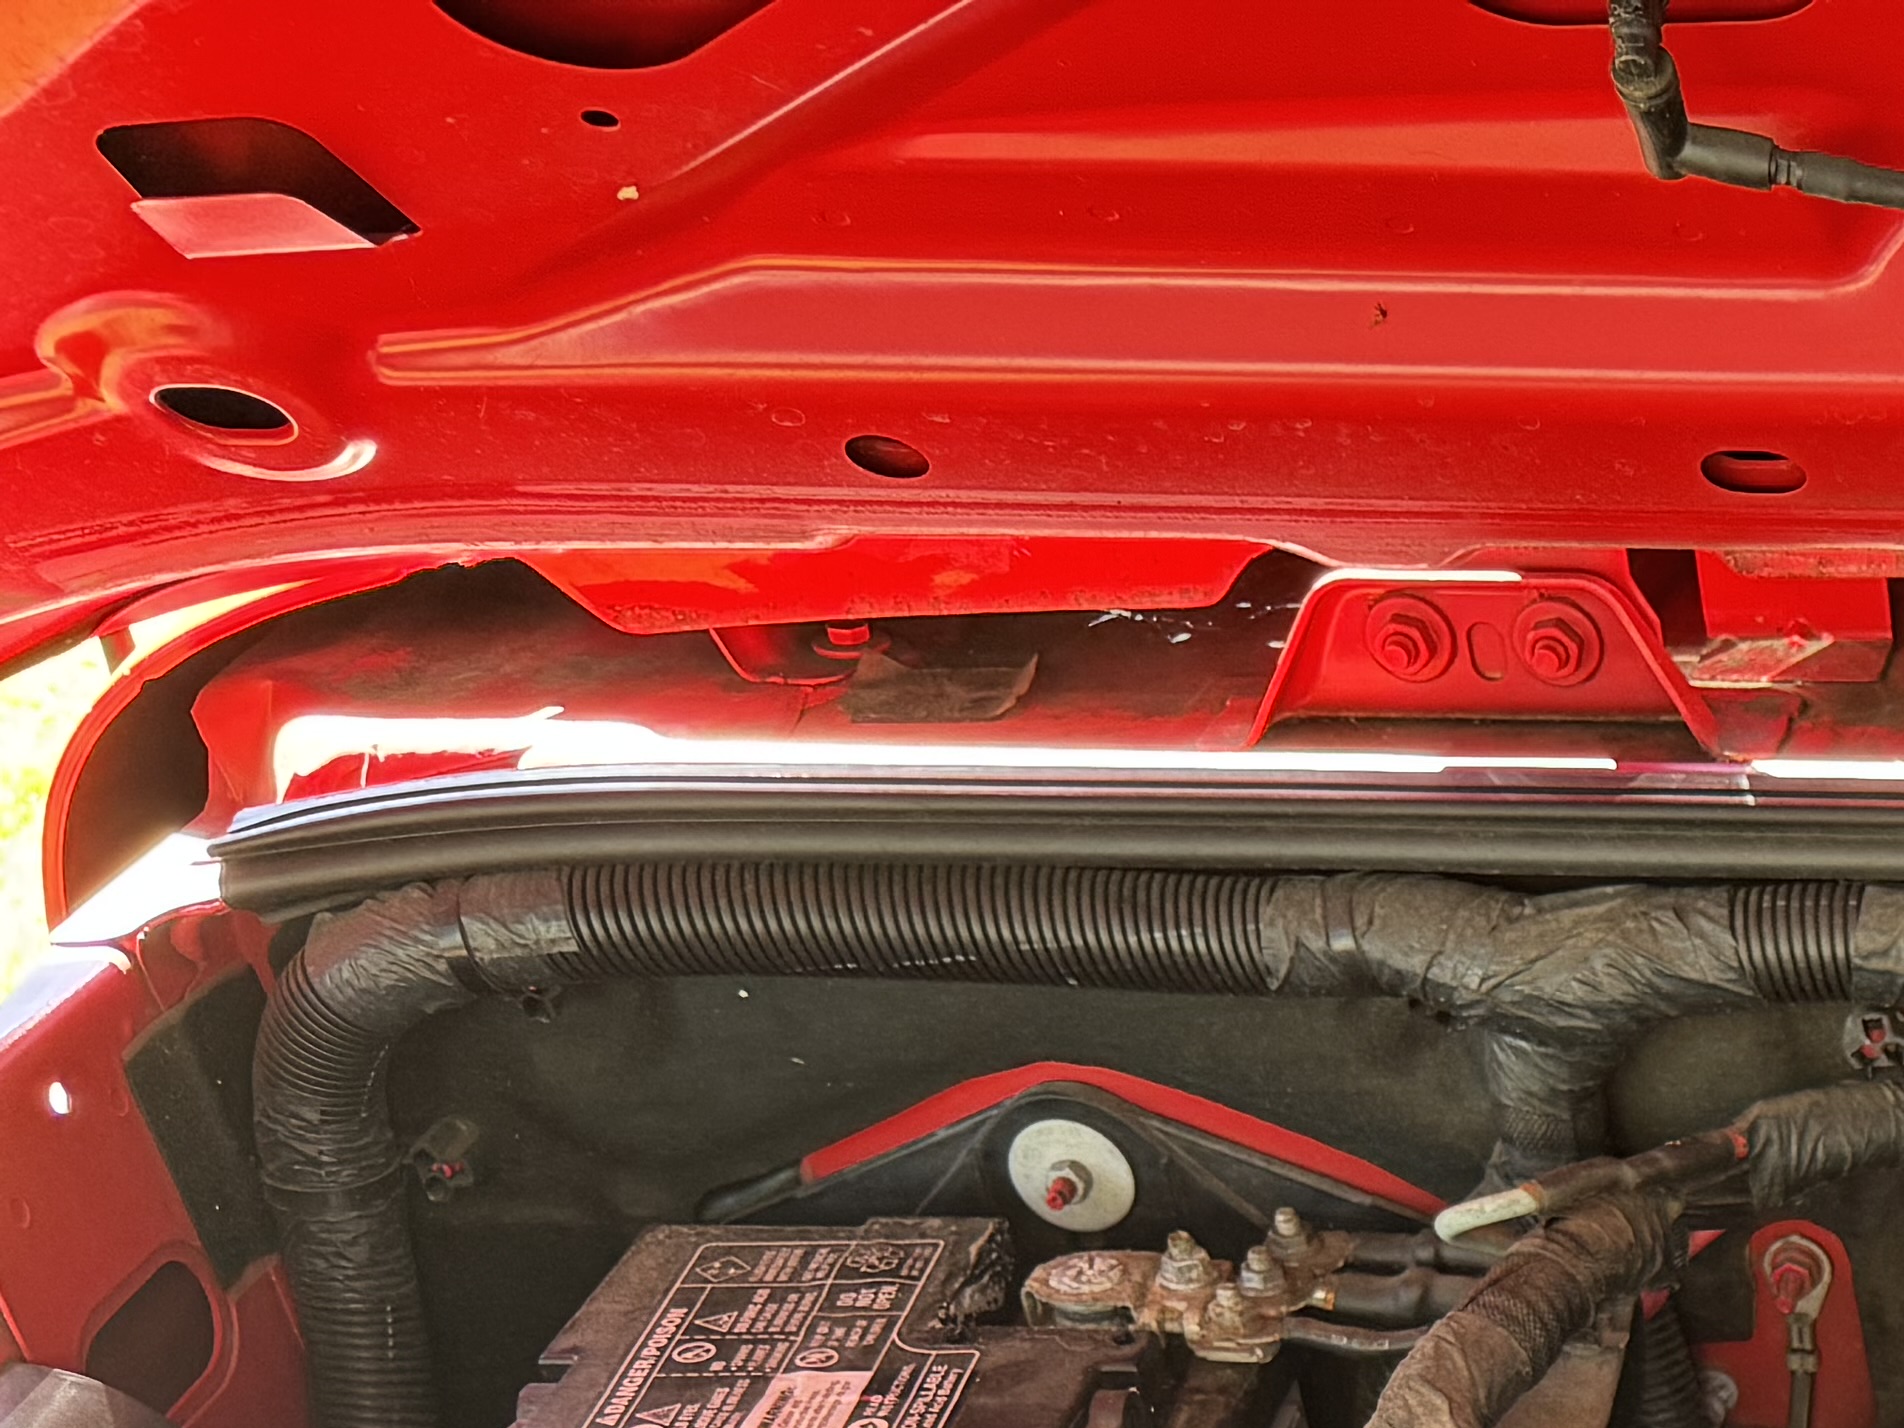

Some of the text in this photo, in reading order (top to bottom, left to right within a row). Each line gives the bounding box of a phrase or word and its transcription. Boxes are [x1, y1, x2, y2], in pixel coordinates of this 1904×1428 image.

[837, 1292, 857, 1307] DO
[855, 1288, 877, 1307] NOT
[612, 1308, 689, 1417] DANGER/POISON
